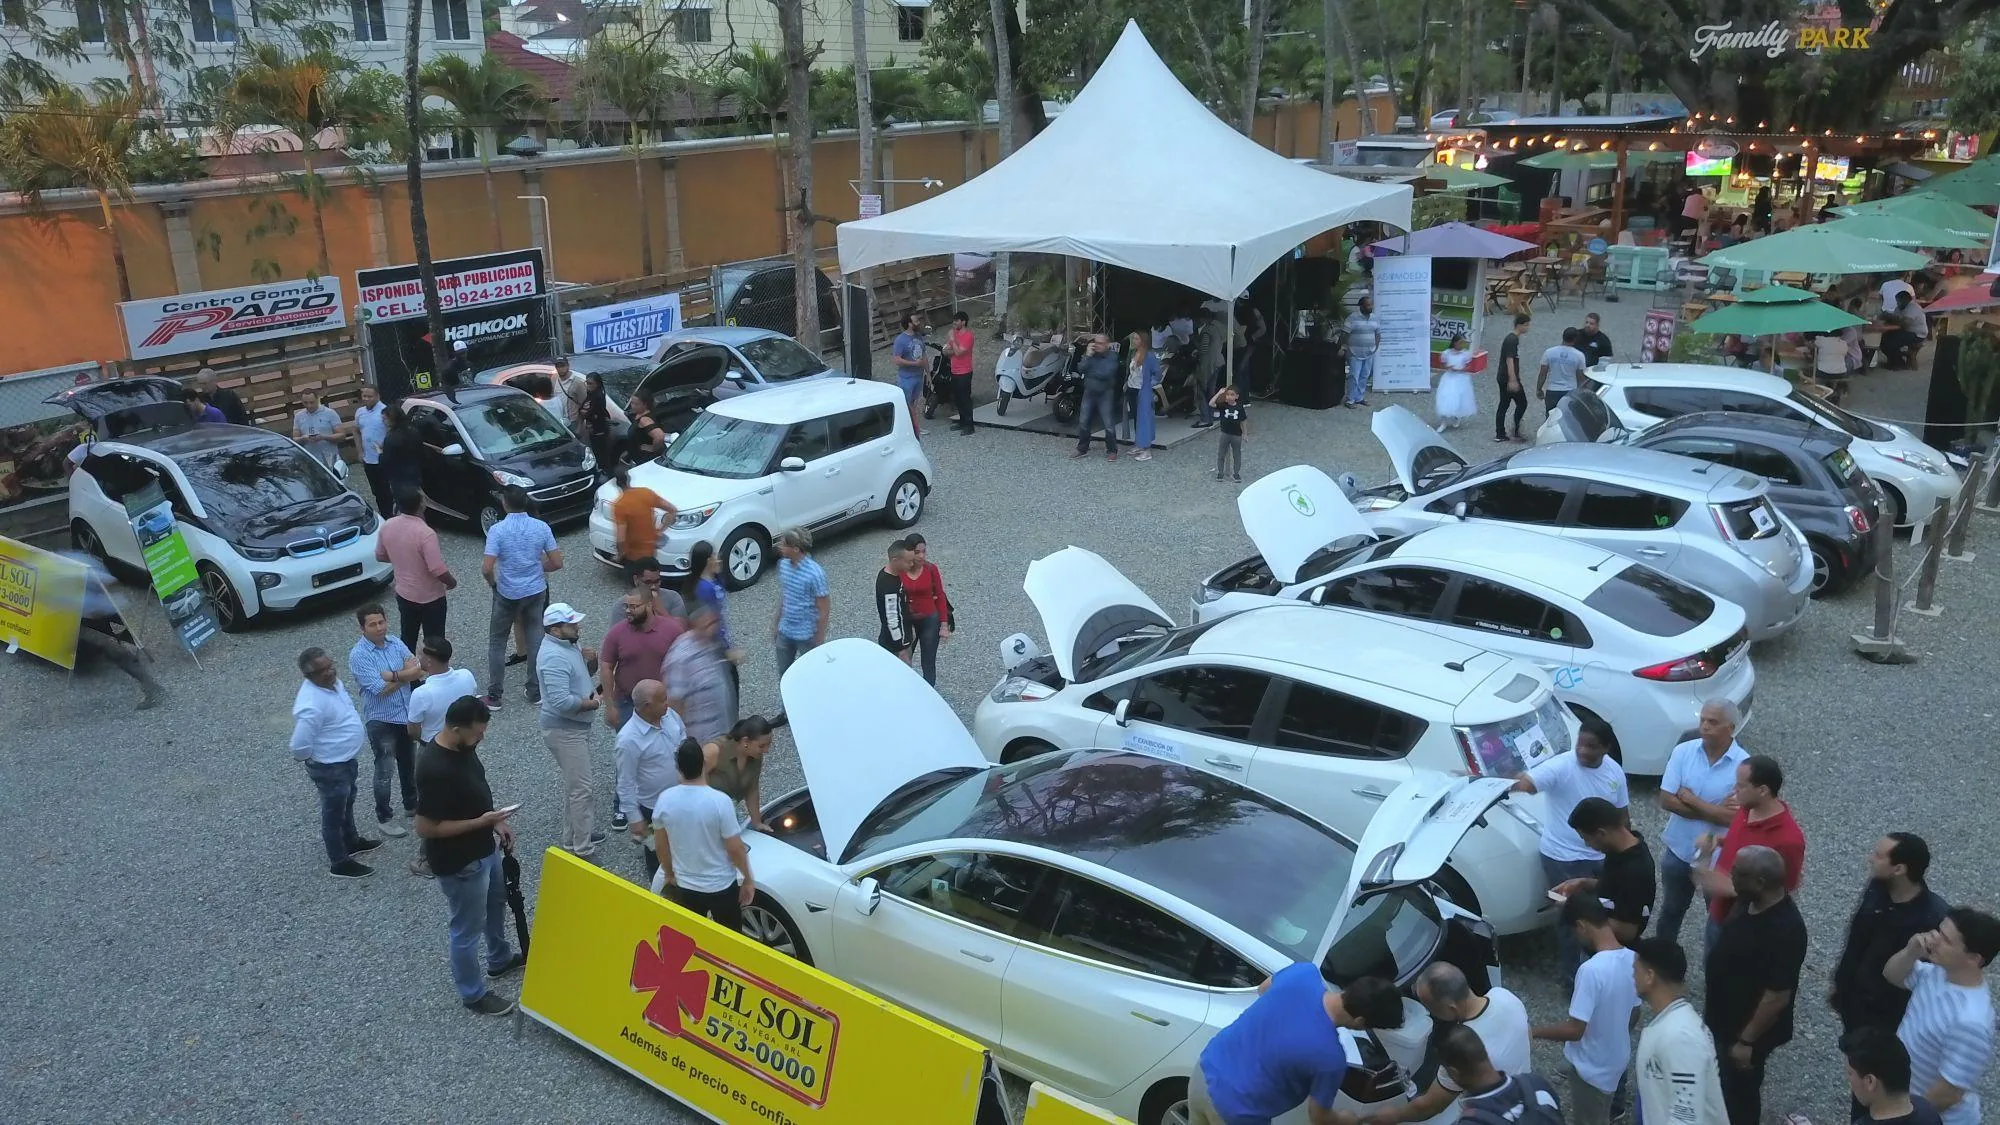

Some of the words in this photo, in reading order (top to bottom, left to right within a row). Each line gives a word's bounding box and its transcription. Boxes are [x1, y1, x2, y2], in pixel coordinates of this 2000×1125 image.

[1690, 20, 1790, 64] Family
[1795, 27, 1872, 49] PARK
[162, 295, 245, 314] Centro
[250, 284, 325, 302] Gomas
[362, 282, 424, 303] ISPONIBL
[436, 276, 462, 291] ARA
[464, 264, 533, 287] PUBLICIDAD
[227, 316, 272, 330] Servicio
[273, 307, 332, 324] Automotriz
[592, 312, 664, 346] INTERSTATE
[609, 340, 644, 353] TIRES
[9, 567, 32, 590] SOL
[709, 973, 752, 1019] EL
[756, 996, 823, 1055] SOL
[705, 1015, 816, 1089] 573-0000
[722, 1011, 733, 1022] DE
[738, 1019, 748, 1030] LA
[784, 1043, 801, 1058] SRL
[619, 1025, 669, 1063] Además
[671, 1051, 687, 1072] de
[688, 1064, 730, 1095] precio
[731, 1090, 748, 1107] es
[750, 1100, 799, 1125] confia
